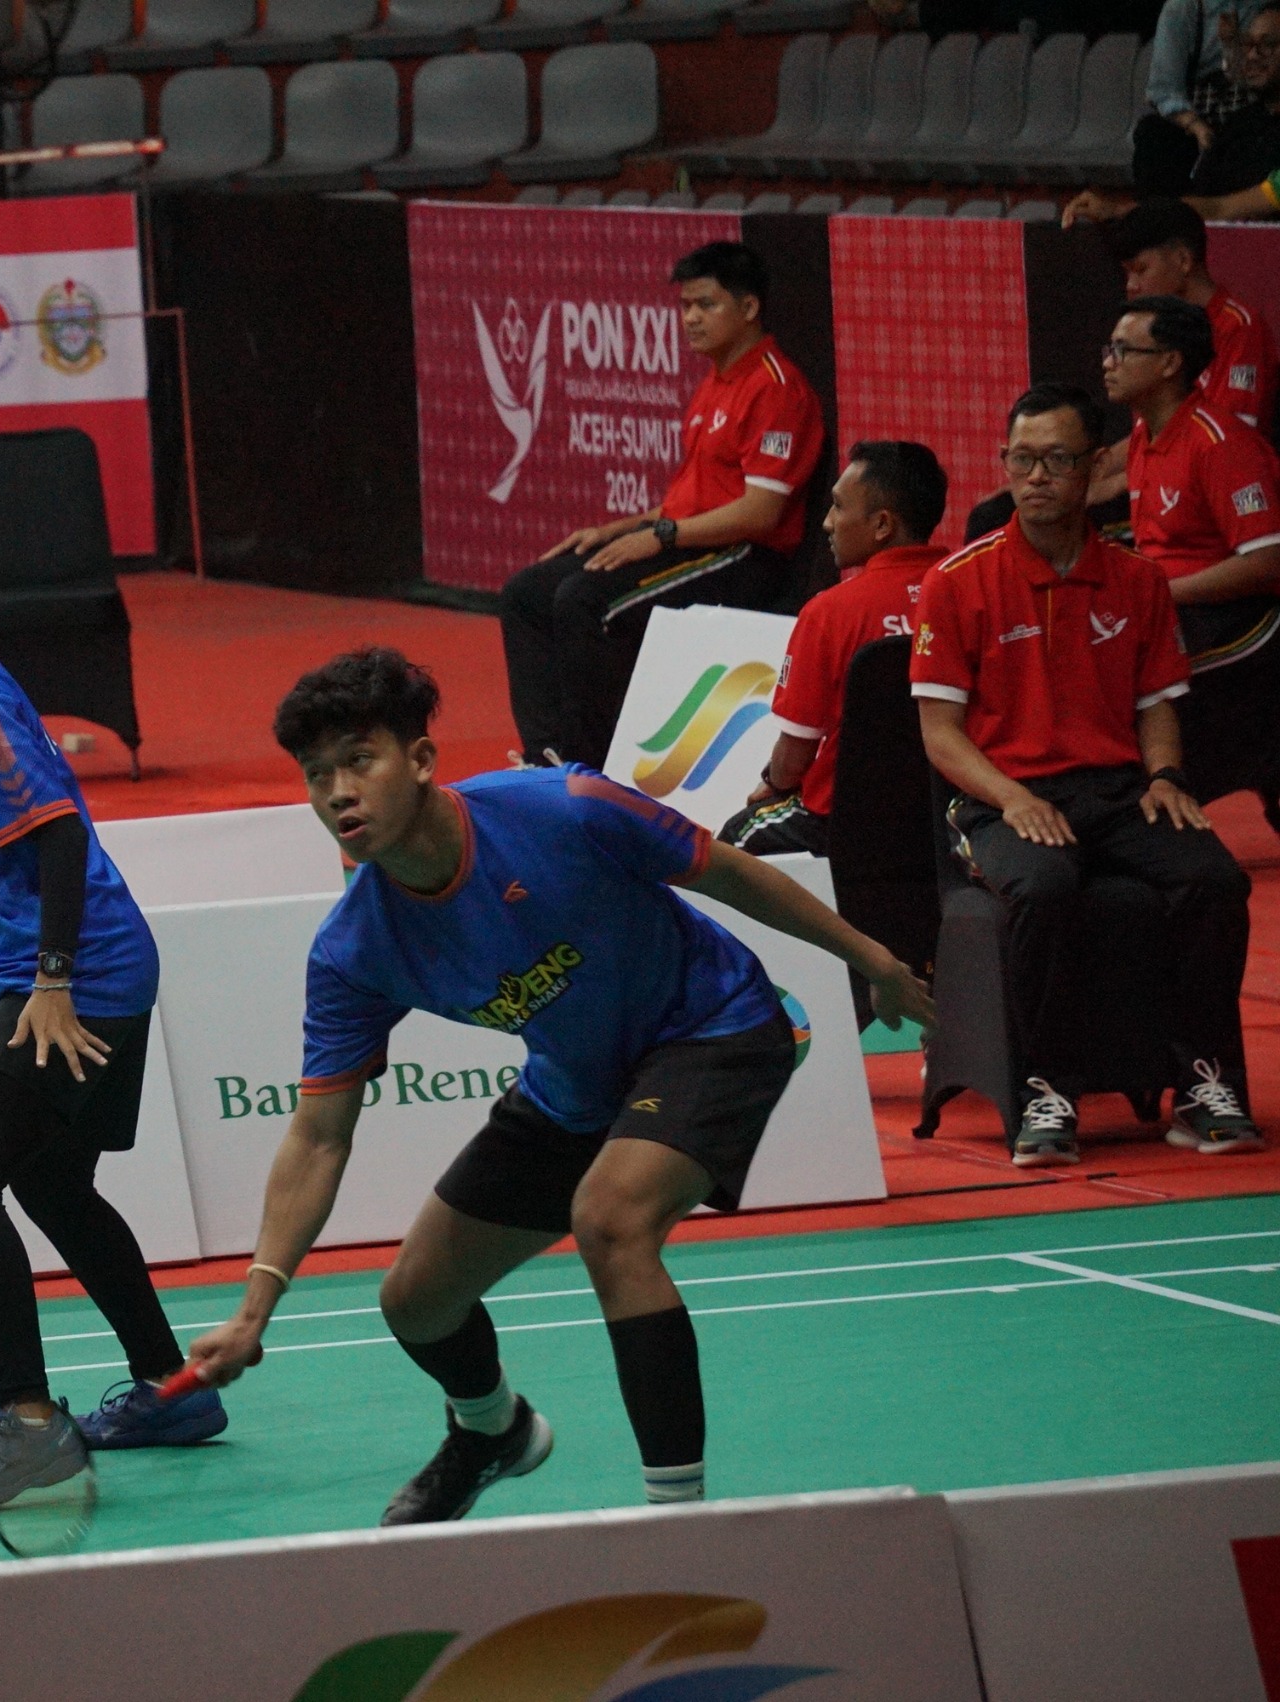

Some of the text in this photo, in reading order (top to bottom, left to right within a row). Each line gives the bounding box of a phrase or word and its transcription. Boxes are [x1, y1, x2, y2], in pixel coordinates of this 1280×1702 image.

[562, 300, 680, 376] PON XXI
[568, 411, 682, 464] ACEH-SUMUT
[605, 469, 649, 514] 2024
[390, 1061, 524, 1106] Rene
